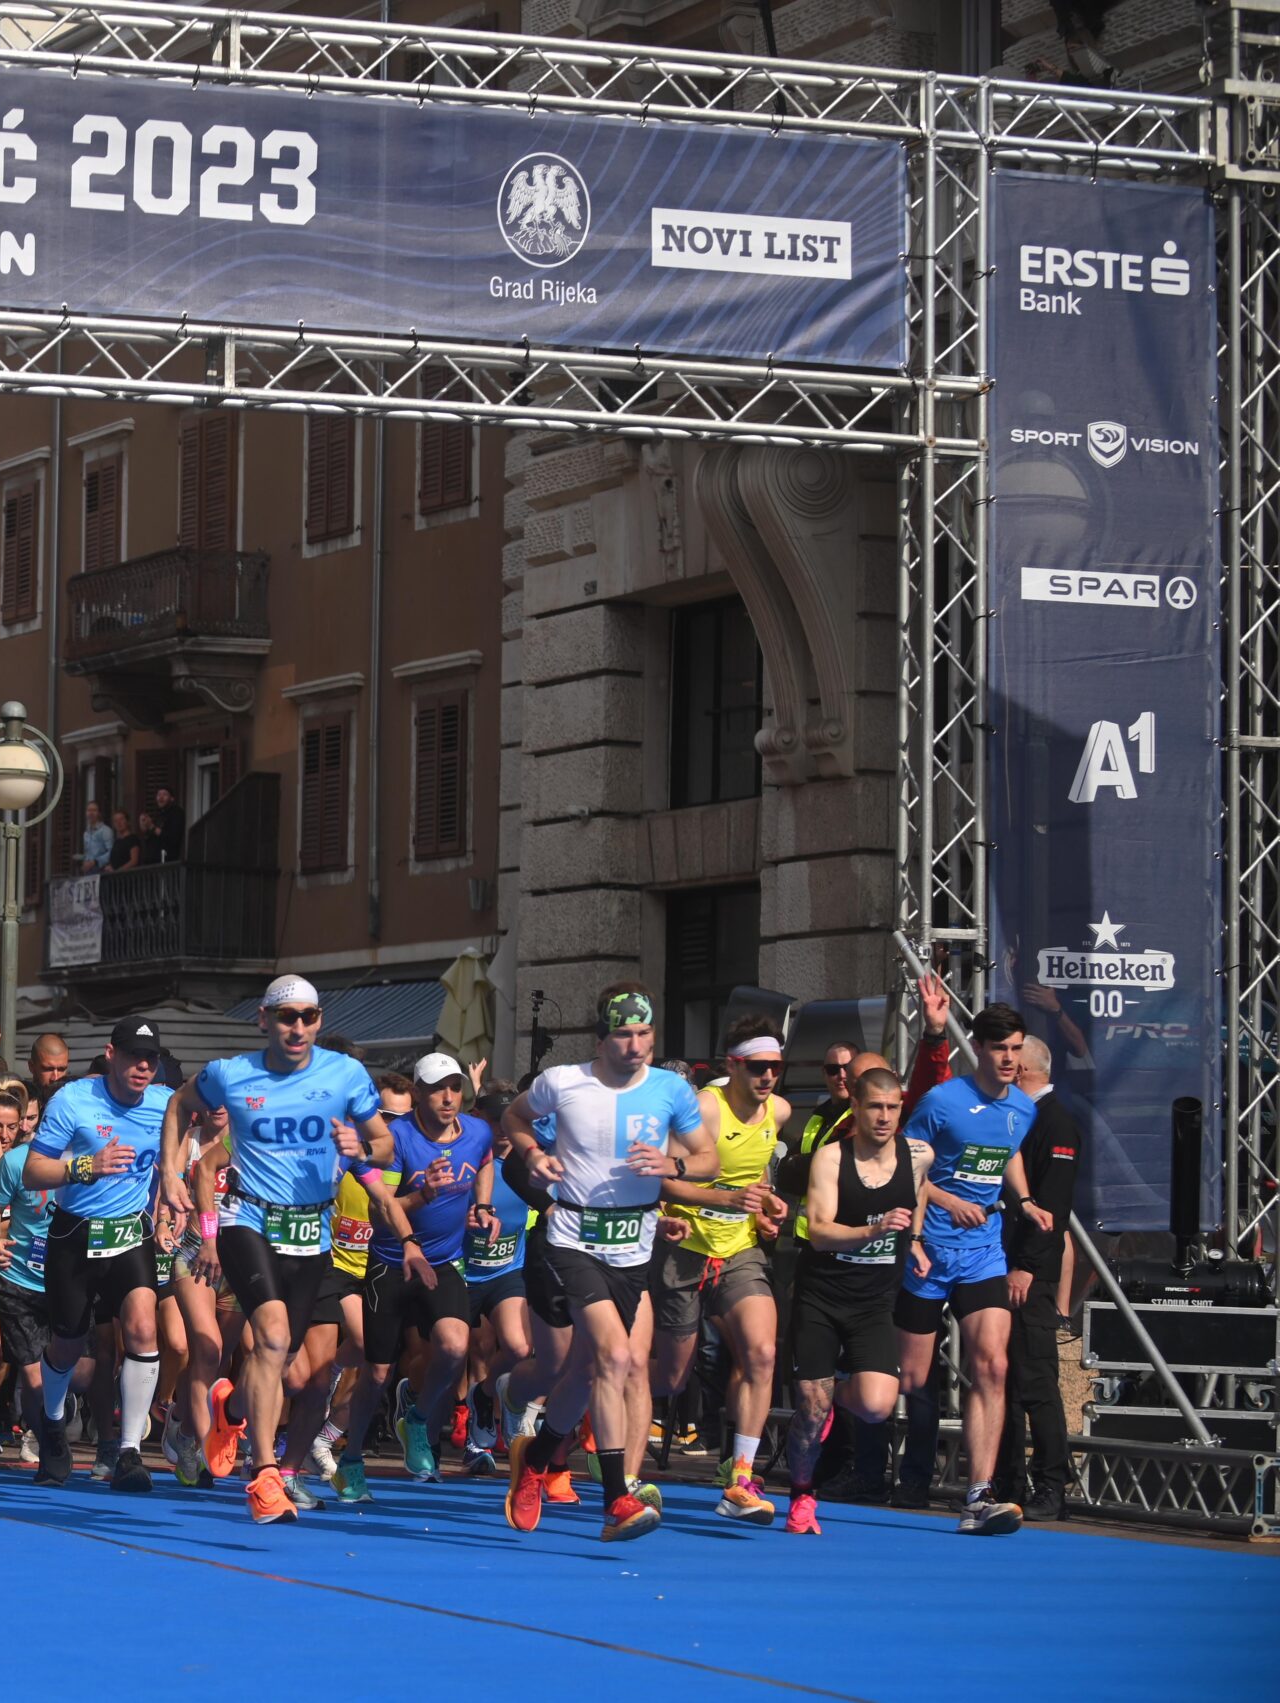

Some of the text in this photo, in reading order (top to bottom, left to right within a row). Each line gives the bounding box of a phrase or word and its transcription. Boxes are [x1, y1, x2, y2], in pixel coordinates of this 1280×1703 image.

[70, 114, 318, 226] 2023
[661, 224, 841, 264] NOVI LIST
[1020, 244, 1144, 293] ERSTE
[489, 275, 598, 306] Grad Rijeka
[1020, 287, 1082, 316] Bank
[1010, 428, 1200, 456] SPORT VISION
[1049, 574, 1157, 601] SPAR
[1067, 711, 1156, 804] A1
[1045, 955, 1167, 982] Heineken
[1089, 989, 1124, 1018] 0.0
[251, 1115, 326, 1144] CRO
[306, 1147, 327, 1156] RIVAL
[976, 1159, 1000, 1172] 887
[114, 1225, 134, 1244] 74
[288, 1221, 320, 1241] 105
[604, 1219, 640, 1240] 120
[488, 1240, 516, 1257] 285
[1151, 1298, 1214, 1308] STADIUM SHOT
